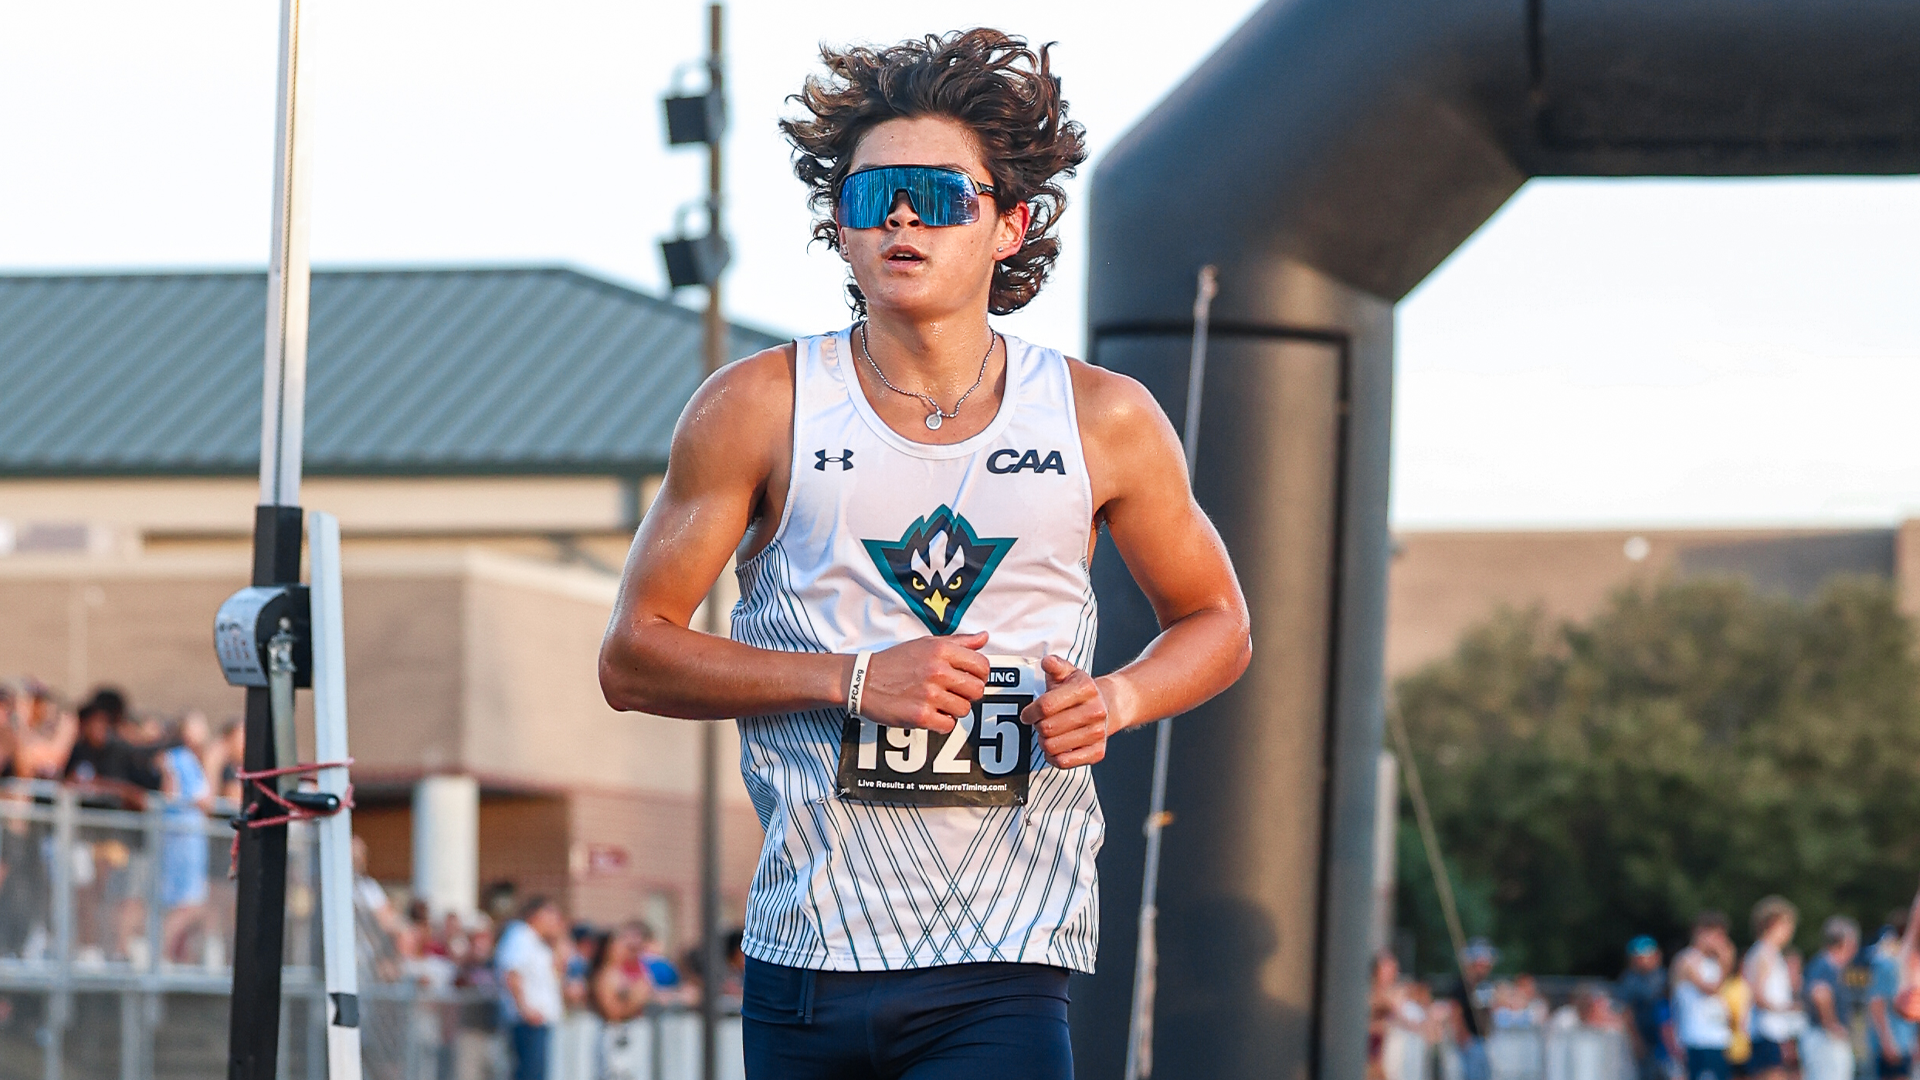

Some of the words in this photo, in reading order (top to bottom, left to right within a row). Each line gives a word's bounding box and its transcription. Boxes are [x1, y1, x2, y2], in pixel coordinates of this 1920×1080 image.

[986, 448, 1066, 475] CAA
[988, 671, 1016, 683] ING
[857, 702, 1020, 775] 1925
[857, 779, 875, 788] Live
[876, 780, 905, 790] Results
